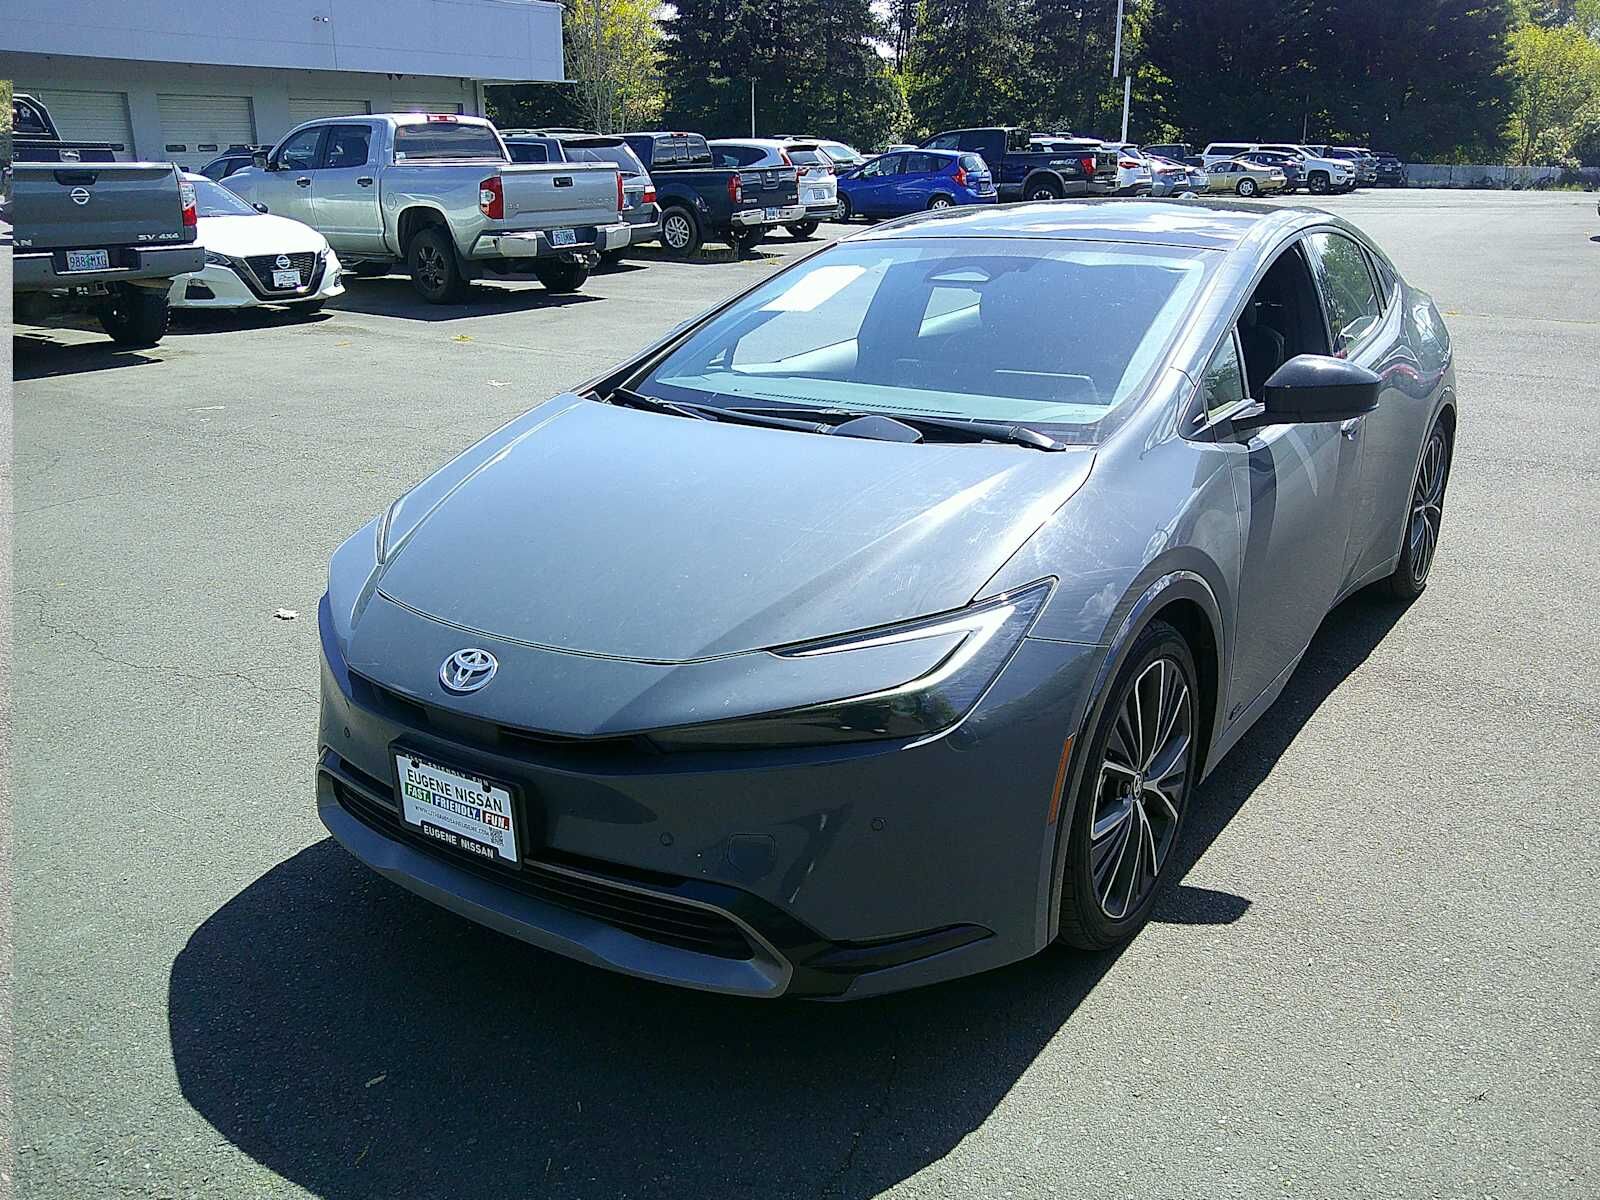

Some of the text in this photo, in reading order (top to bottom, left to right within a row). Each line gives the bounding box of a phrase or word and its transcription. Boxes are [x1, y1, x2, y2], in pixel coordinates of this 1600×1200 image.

[70, 254, 86, 268] 988
[406, 768, 503, 813] EUGENE NISSAN
[407, 783, 509, 830] FAST. FRIENDLY. FUN.
[423, 825, 494, 859] EUGENE NISSAN
